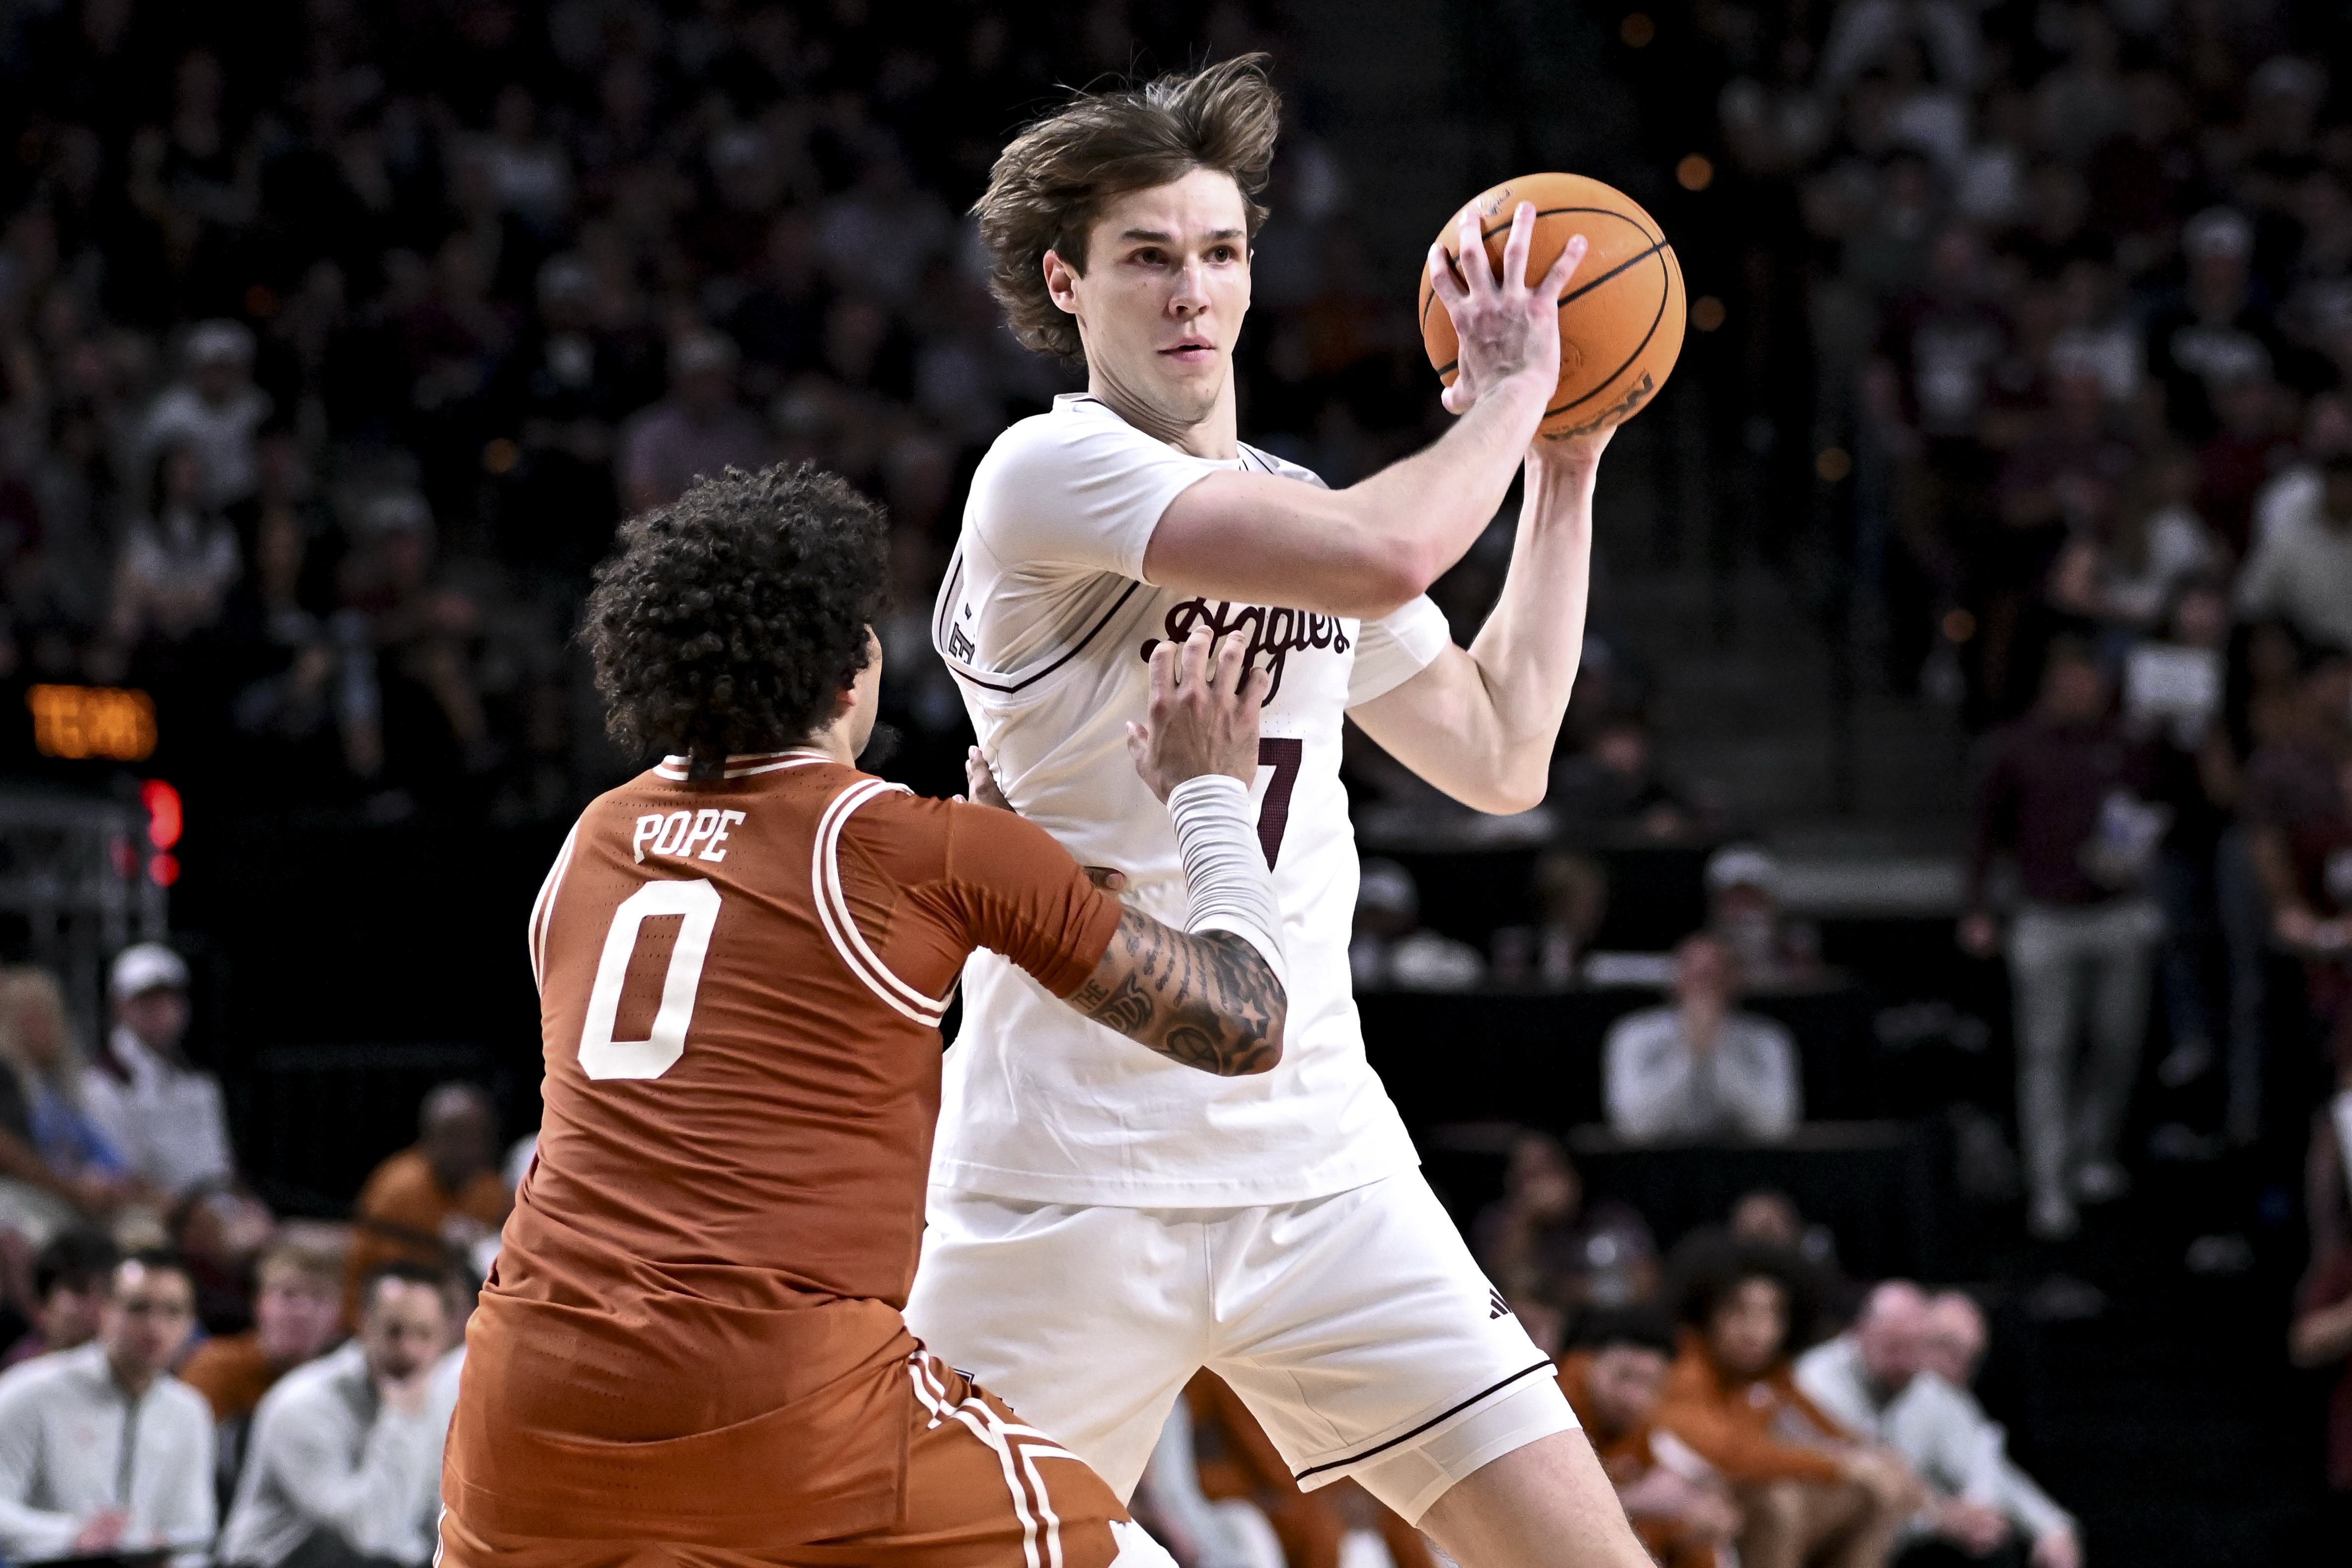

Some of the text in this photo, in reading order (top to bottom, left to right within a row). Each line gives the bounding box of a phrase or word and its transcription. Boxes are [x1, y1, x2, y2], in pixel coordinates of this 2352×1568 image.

[634, 808, 746, 865] POPE
[1256, 736, 1303, 874] 7
[577, 878, 723, 1080] 0
